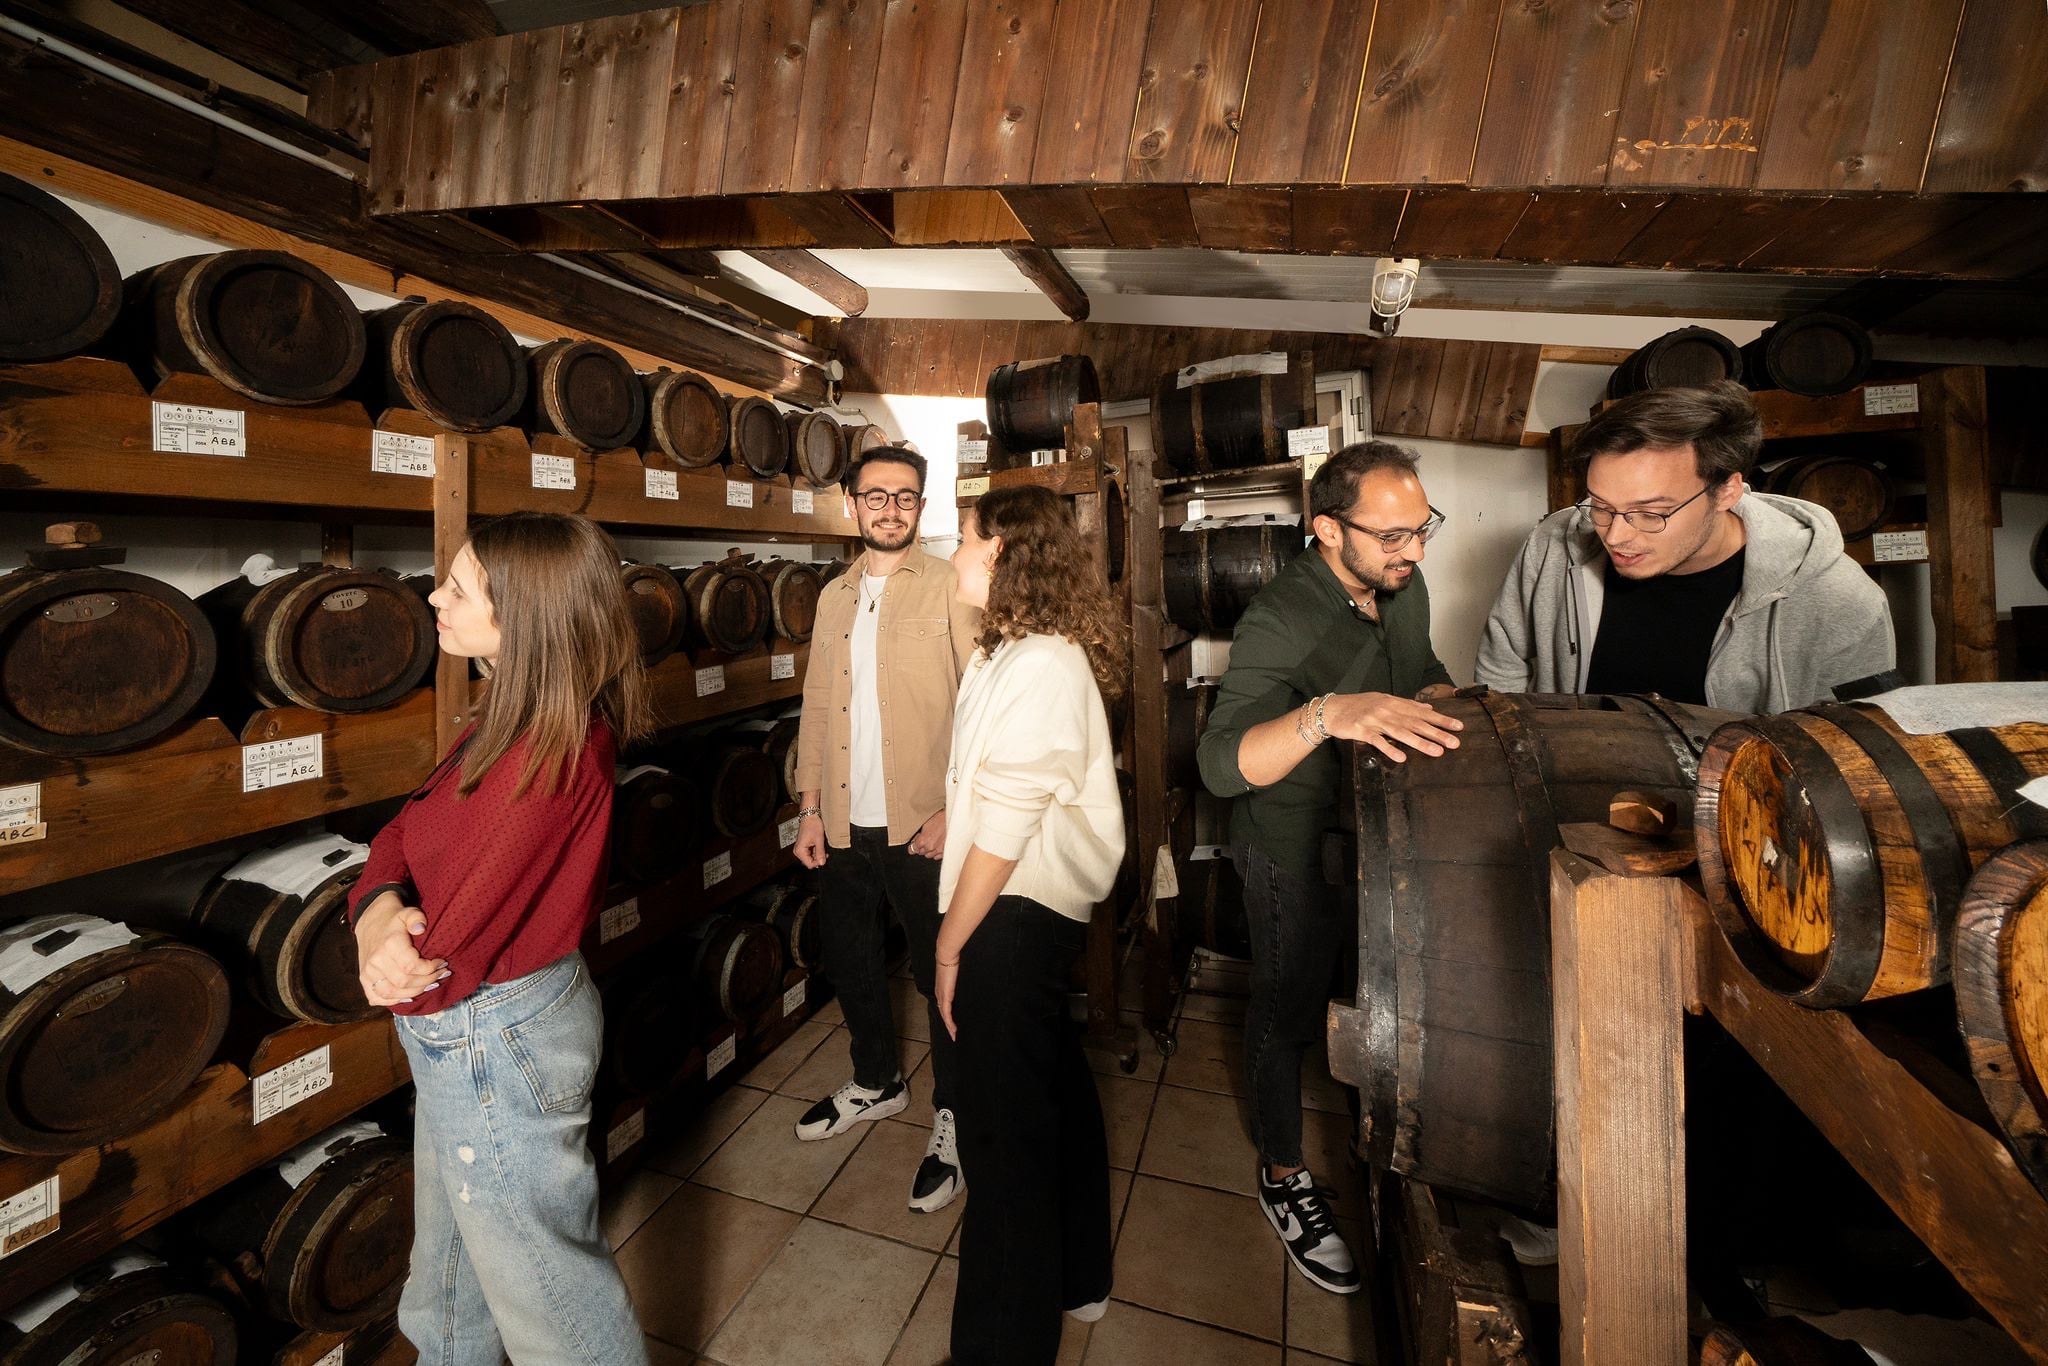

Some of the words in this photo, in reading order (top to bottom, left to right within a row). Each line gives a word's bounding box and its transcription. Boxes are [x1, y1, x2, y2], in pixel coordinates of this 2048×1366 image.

[211, 435, 237, 446] ABB
[340, 598, 353, 609] 10
[291, 764, 318, 778] ABC
